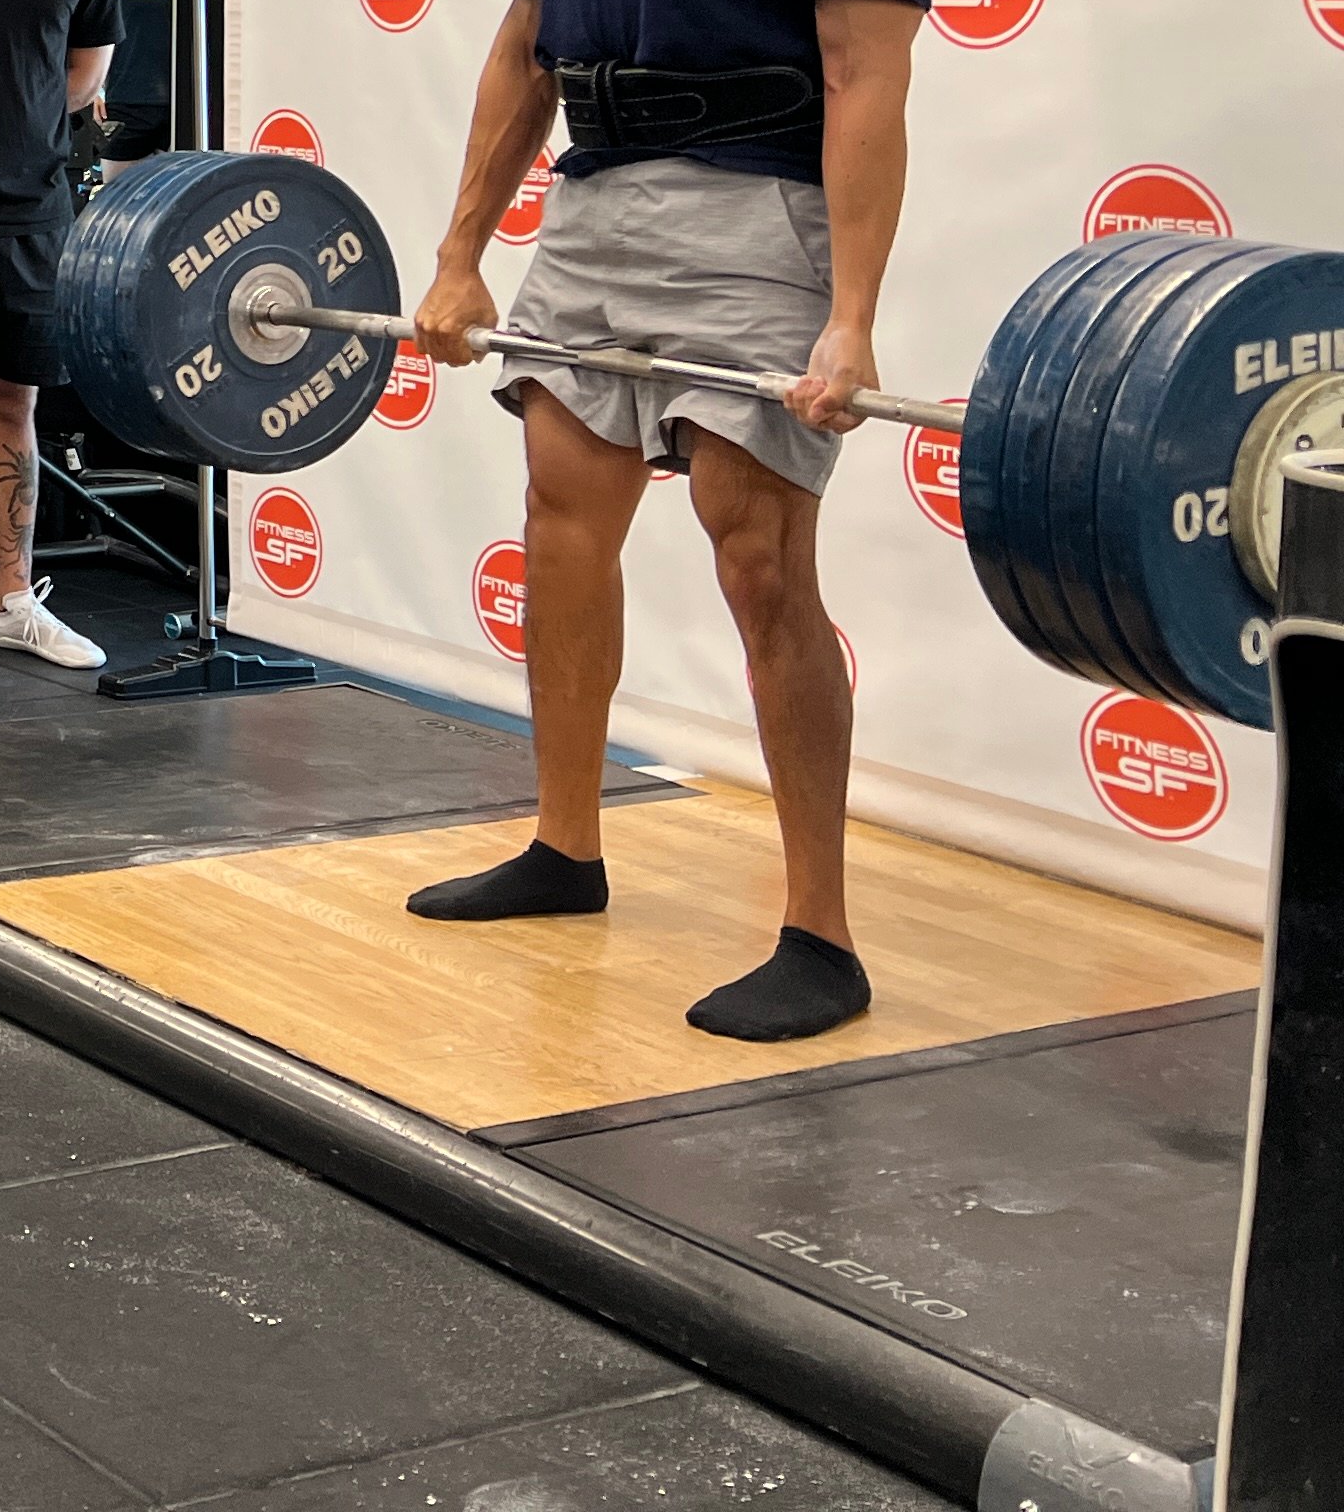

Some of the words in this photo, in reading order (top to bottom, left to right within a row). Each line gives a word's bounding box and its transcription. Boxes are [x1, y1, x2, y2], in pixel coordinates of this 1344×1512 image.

[168, 189, 281, 292] ELEIKO
[316, 230, 364, 286] 20
[174, 343, 224, 400] 20
[260, 334, 371, 439] ELEIKO
[1234, 328, 1344, 396] ELEI
[255, 518, 315, 546] FITNESS
[265, 538, 305, 568] SF
[480, 574, 527, 599] FITNE
[1095, 728, 1210, 772] FITNESS
[1116, 756, 1188, 798] SF
[754, 1229, 968, 1320] ELEIKO
